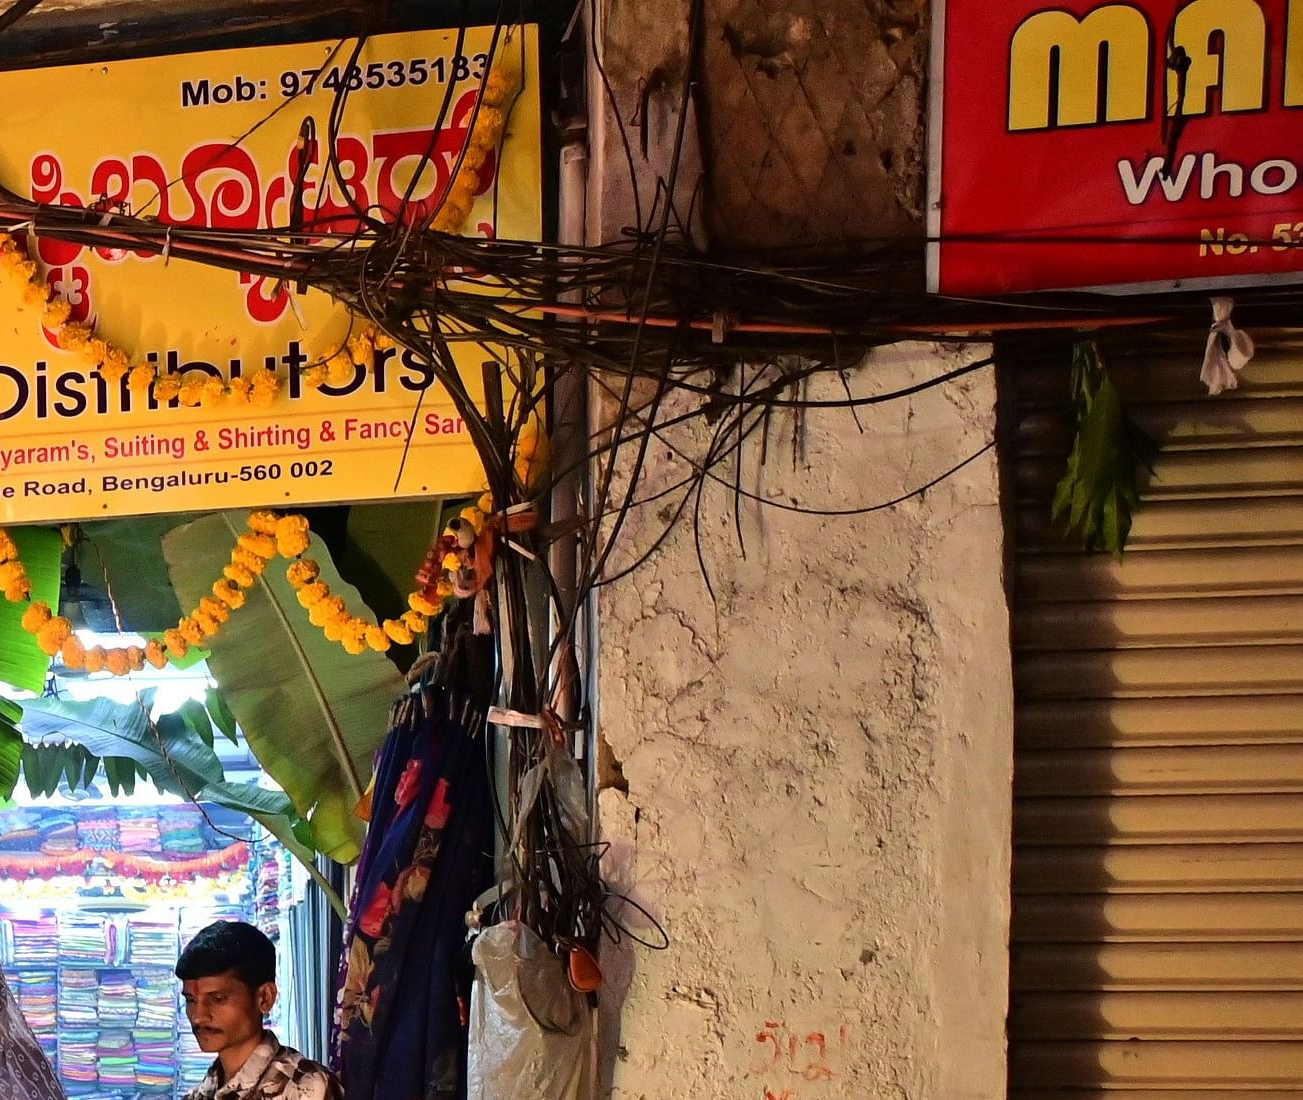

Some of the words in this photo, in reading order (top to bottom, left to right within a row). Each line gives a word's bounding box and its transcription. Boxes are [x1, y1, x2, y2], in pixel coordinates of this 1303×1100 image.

[1008, 0, 1303, 131] MA
[181, 76, 268, 108] Mob:
[1199, 227, 1258, 257] No.
[104, 432, 185, 464] Suiting
[193, 429, 210, 453] &
[217, 421, 312, 453] Shirting
[319, 419, 337, 443] &
[344, 414, 412, 443] Fancy
[24, 477, 92, 500] Road,
[102, 462, 282, 495] Bengaluru-560
[290, 459, 334, 479] 002
